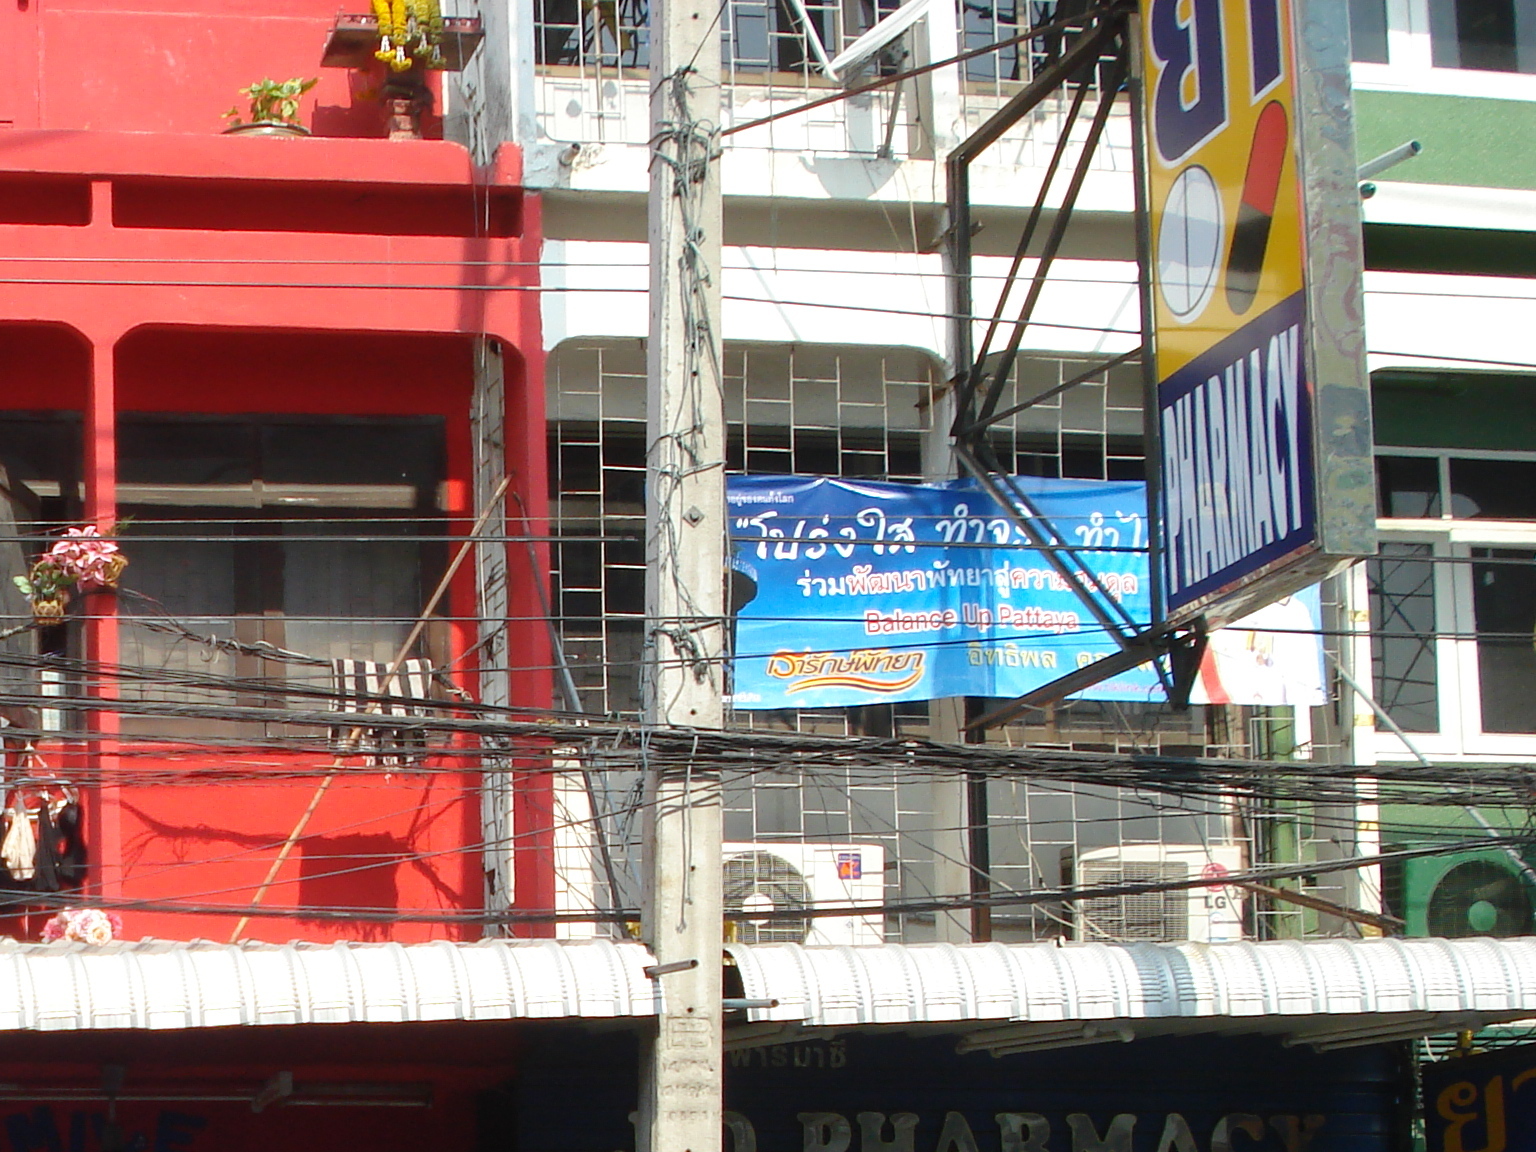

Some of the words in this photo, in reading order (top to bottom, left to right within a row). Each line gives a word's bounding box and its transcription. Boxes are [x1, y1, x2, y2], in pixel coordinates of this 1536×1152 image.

[1164, 324, 1303, 596] PHARMACY
[866, 610, 956, 634] Balance
[963, 604, 992, 632] Up
[999, 605, 1079, 634] Pattaya
